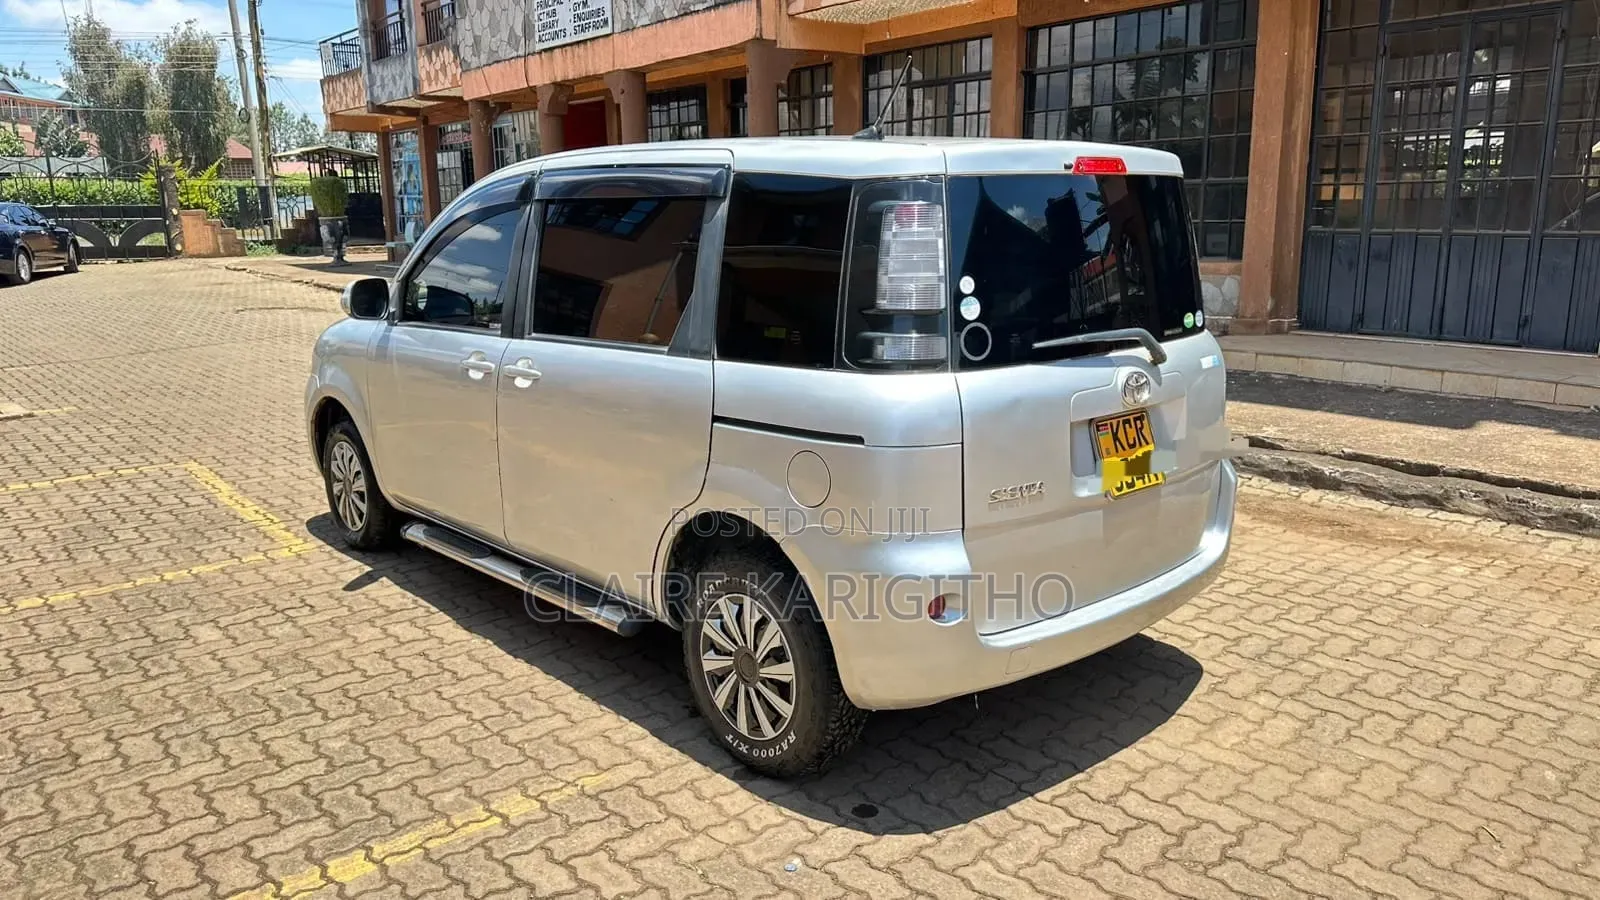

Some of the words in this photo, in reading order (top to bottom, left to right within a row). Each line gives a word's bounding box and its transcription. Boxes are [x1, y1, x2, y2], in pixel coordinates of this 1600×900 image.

[573, 6, 605, 23] ENQUIRIES
[538, 17, 559, 32] LIBRARY
[538, 28, 567, 43] ACCOUNTS
[1109, 413, 1150, 453] KCR
[752, 729, 797, 758] RA7000
